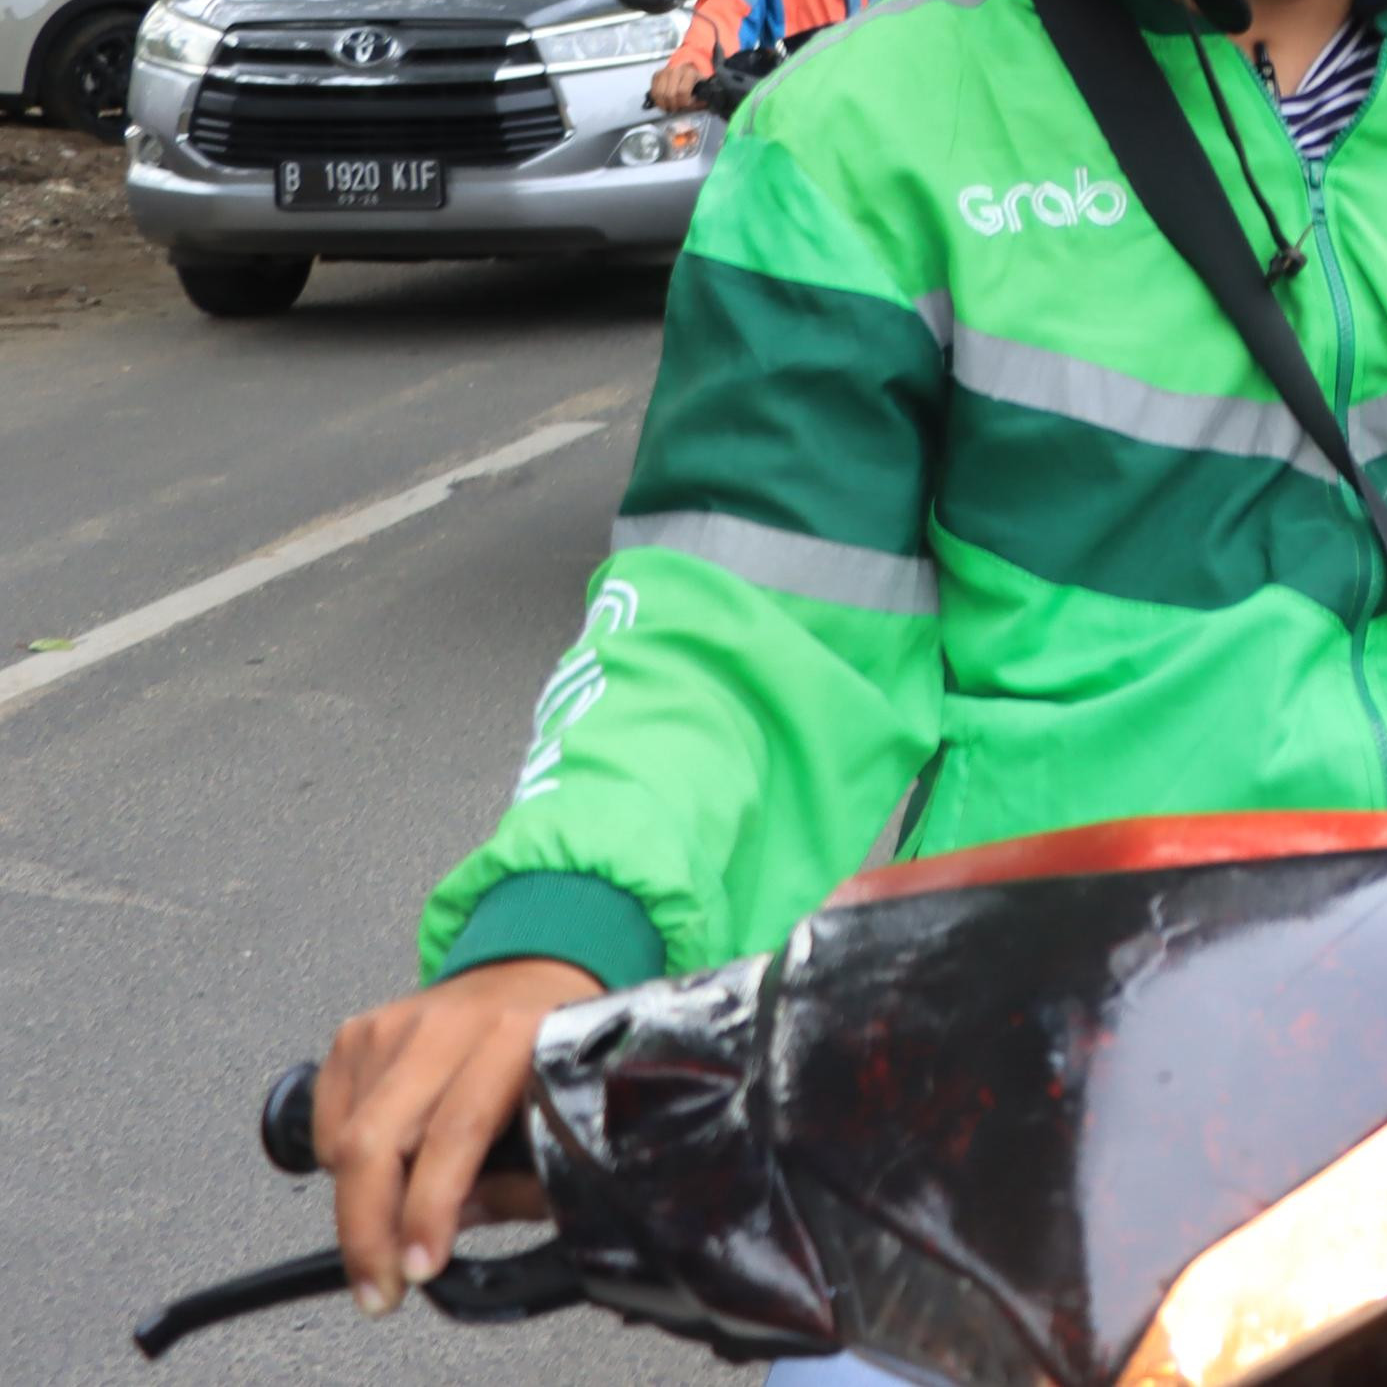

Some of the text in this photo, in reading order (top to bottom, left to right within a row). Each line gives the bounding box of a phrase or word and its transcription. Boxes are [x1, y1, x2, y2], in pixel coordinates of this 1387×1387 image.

[284, 161, 437, 192] B 1920 KIF
[958, 166, 1128, 237] Grab
